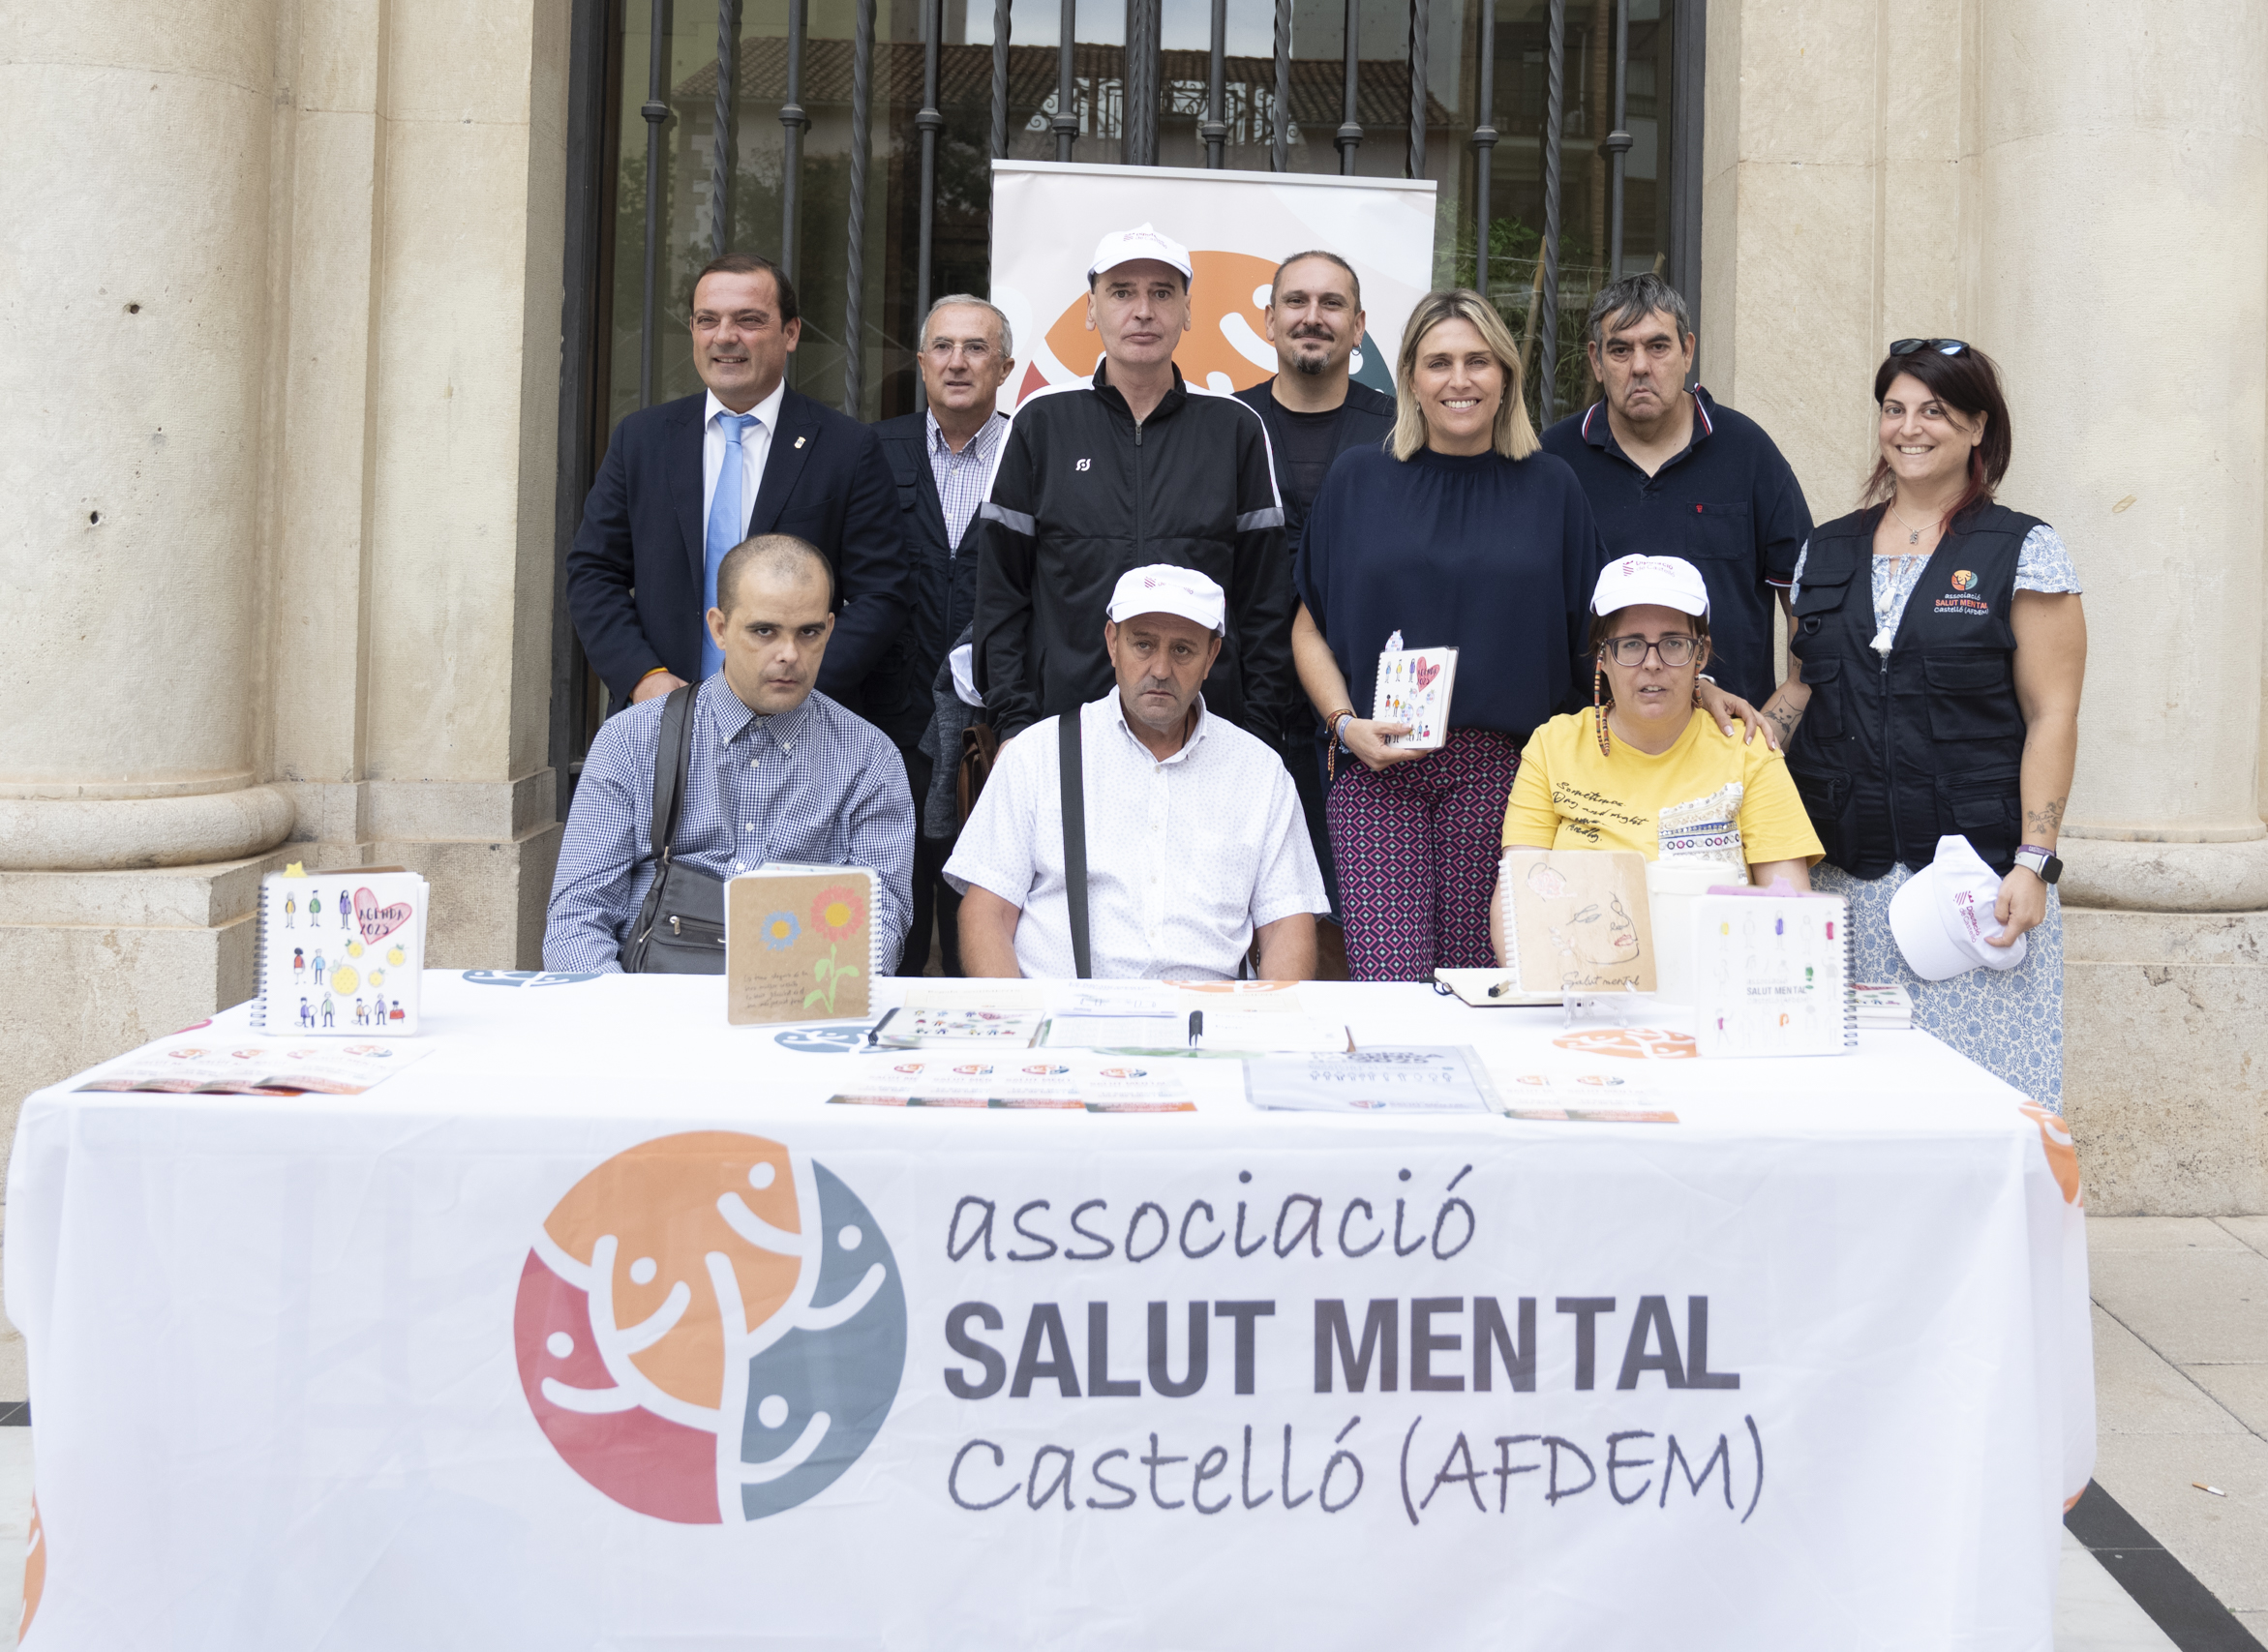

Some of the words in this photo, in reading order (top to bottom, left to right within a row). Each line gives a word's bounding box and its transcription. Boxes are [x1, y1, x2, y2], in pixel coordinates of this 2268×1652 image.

[1944, 591, 1981, 601] associació
[1935, 598, 1958, 607] SALUT
[1959, 598, 1988, 610] MENTAL
[359, 907, 405, 921] AGENDA
[1966, 905, 1982, 936] Diputació
[359, 923, 390, 936] 2025
[1746, 985, 1772, 996] SALUT
[1774, 984, 1807, 995] MENTAL
[947, 1163, 1476, 1263] associació
[943, 1299, 1277, 1400] SALUT
[1313, 1294, 1741, 1395] MENTAL
[1400, 1414, 1765, 1526] (AFDEM)
